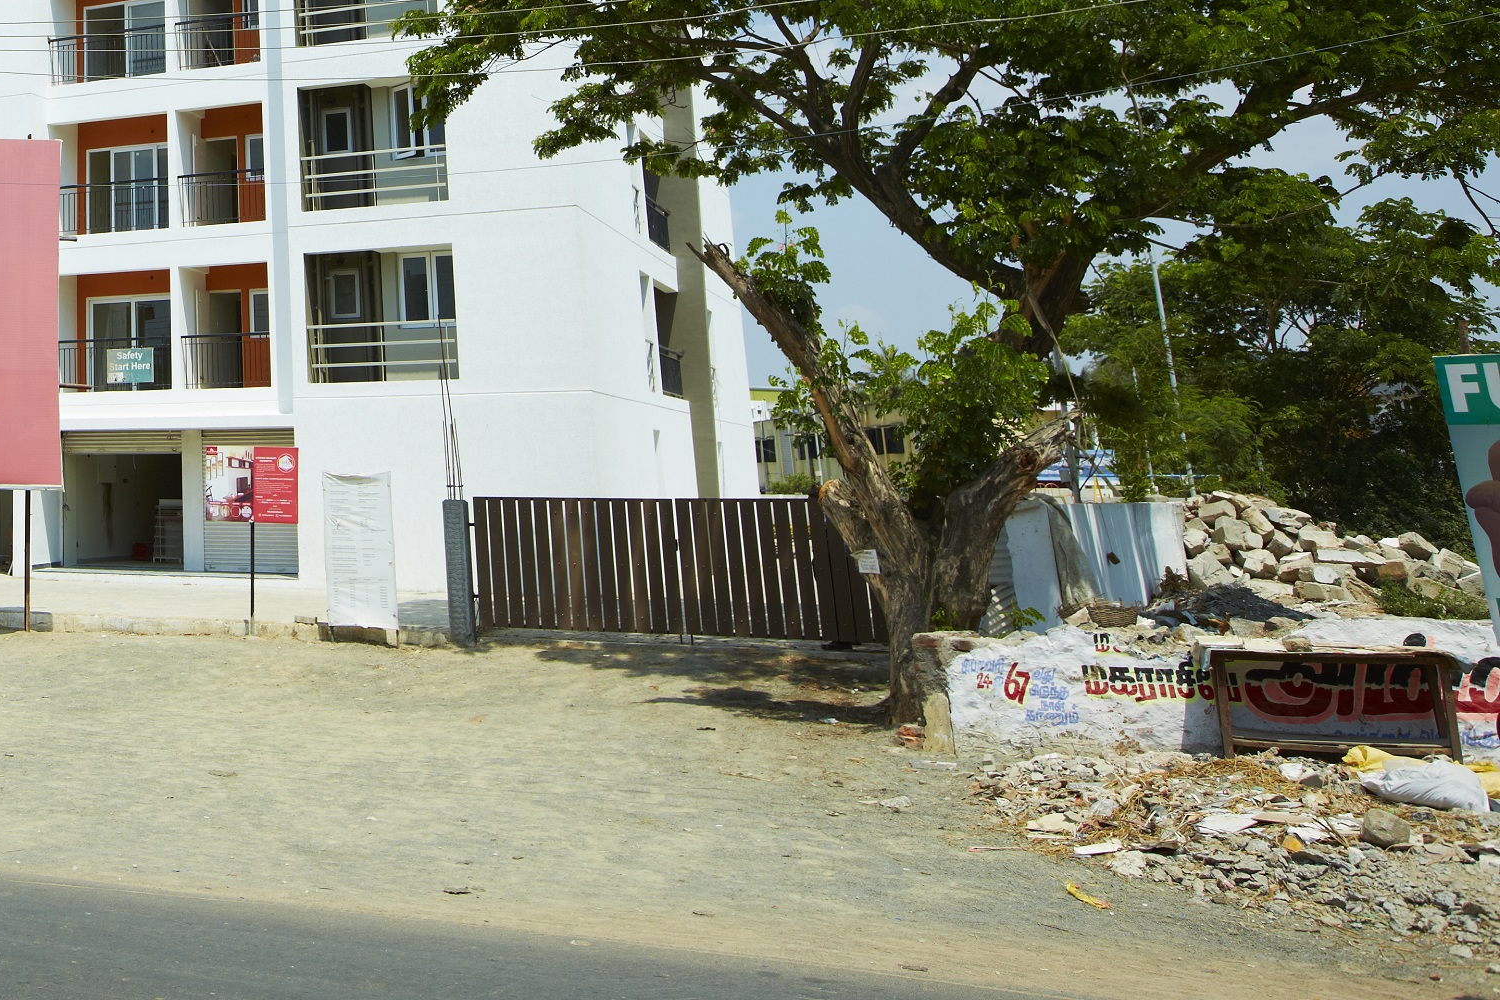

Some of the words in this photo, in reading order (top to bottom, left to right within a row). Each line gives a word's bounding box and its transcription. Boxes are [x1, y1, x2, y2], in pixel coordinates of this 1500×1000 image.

[116, 350, 143, 361] Safety
[110, 363, 129, 371] Start
[131, 362, 151, 370] Here
[976, 672, 993, 688] 24
[1003, 661, 1030, 704] 67
